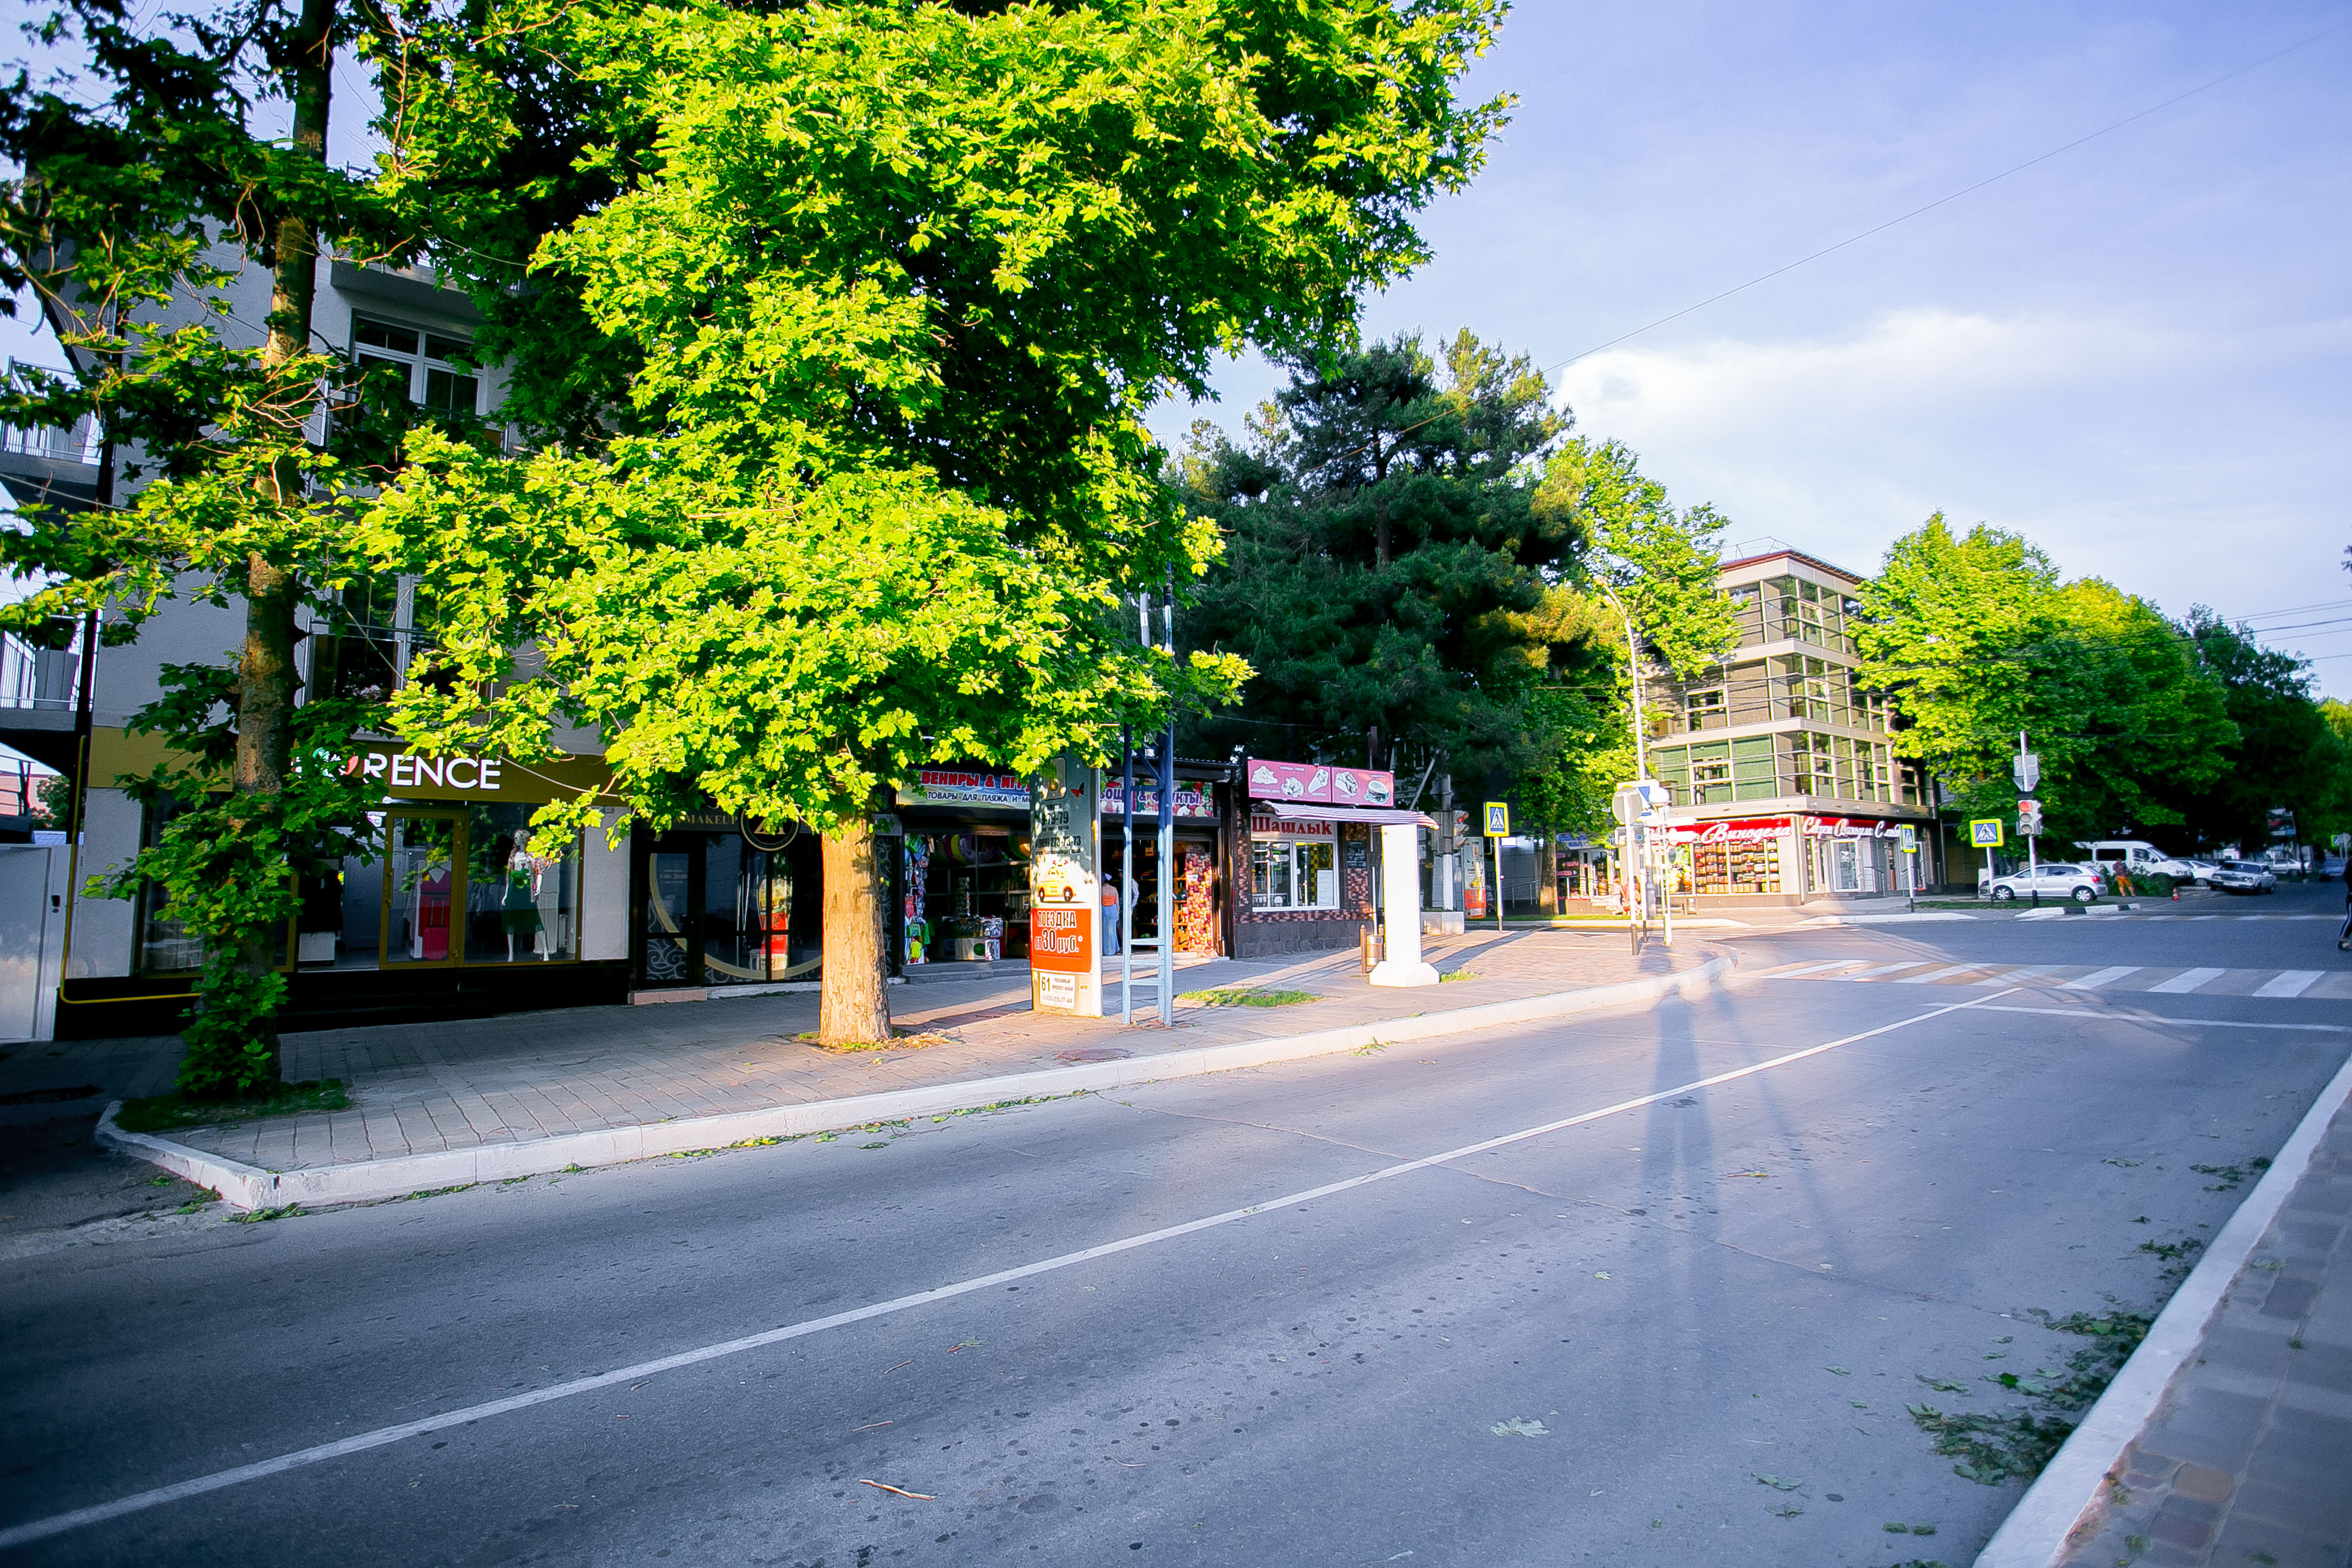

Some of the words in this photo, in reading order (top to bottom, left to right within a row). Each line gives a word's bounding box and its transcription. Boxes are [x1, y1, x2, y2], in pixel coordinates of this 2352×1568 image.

[920, 772, 979, 787] ВЕНИРЫ
[985, 775, 994, 787] &
[928, 792, 958, 800] ТОВАРЫ
[962, 794, 978, 802] ДЛЯ
[1251, 817, 1332, 835] Шашлык
[1701, 823, 1791, 845] Винодела
[1038, 912, 1076, 929] ПОЕЗДКА
[1035, 937, 1042, 949] от
[1043, 929, 1055, 950] 30
[1041, 976, 1050, 991] 61
